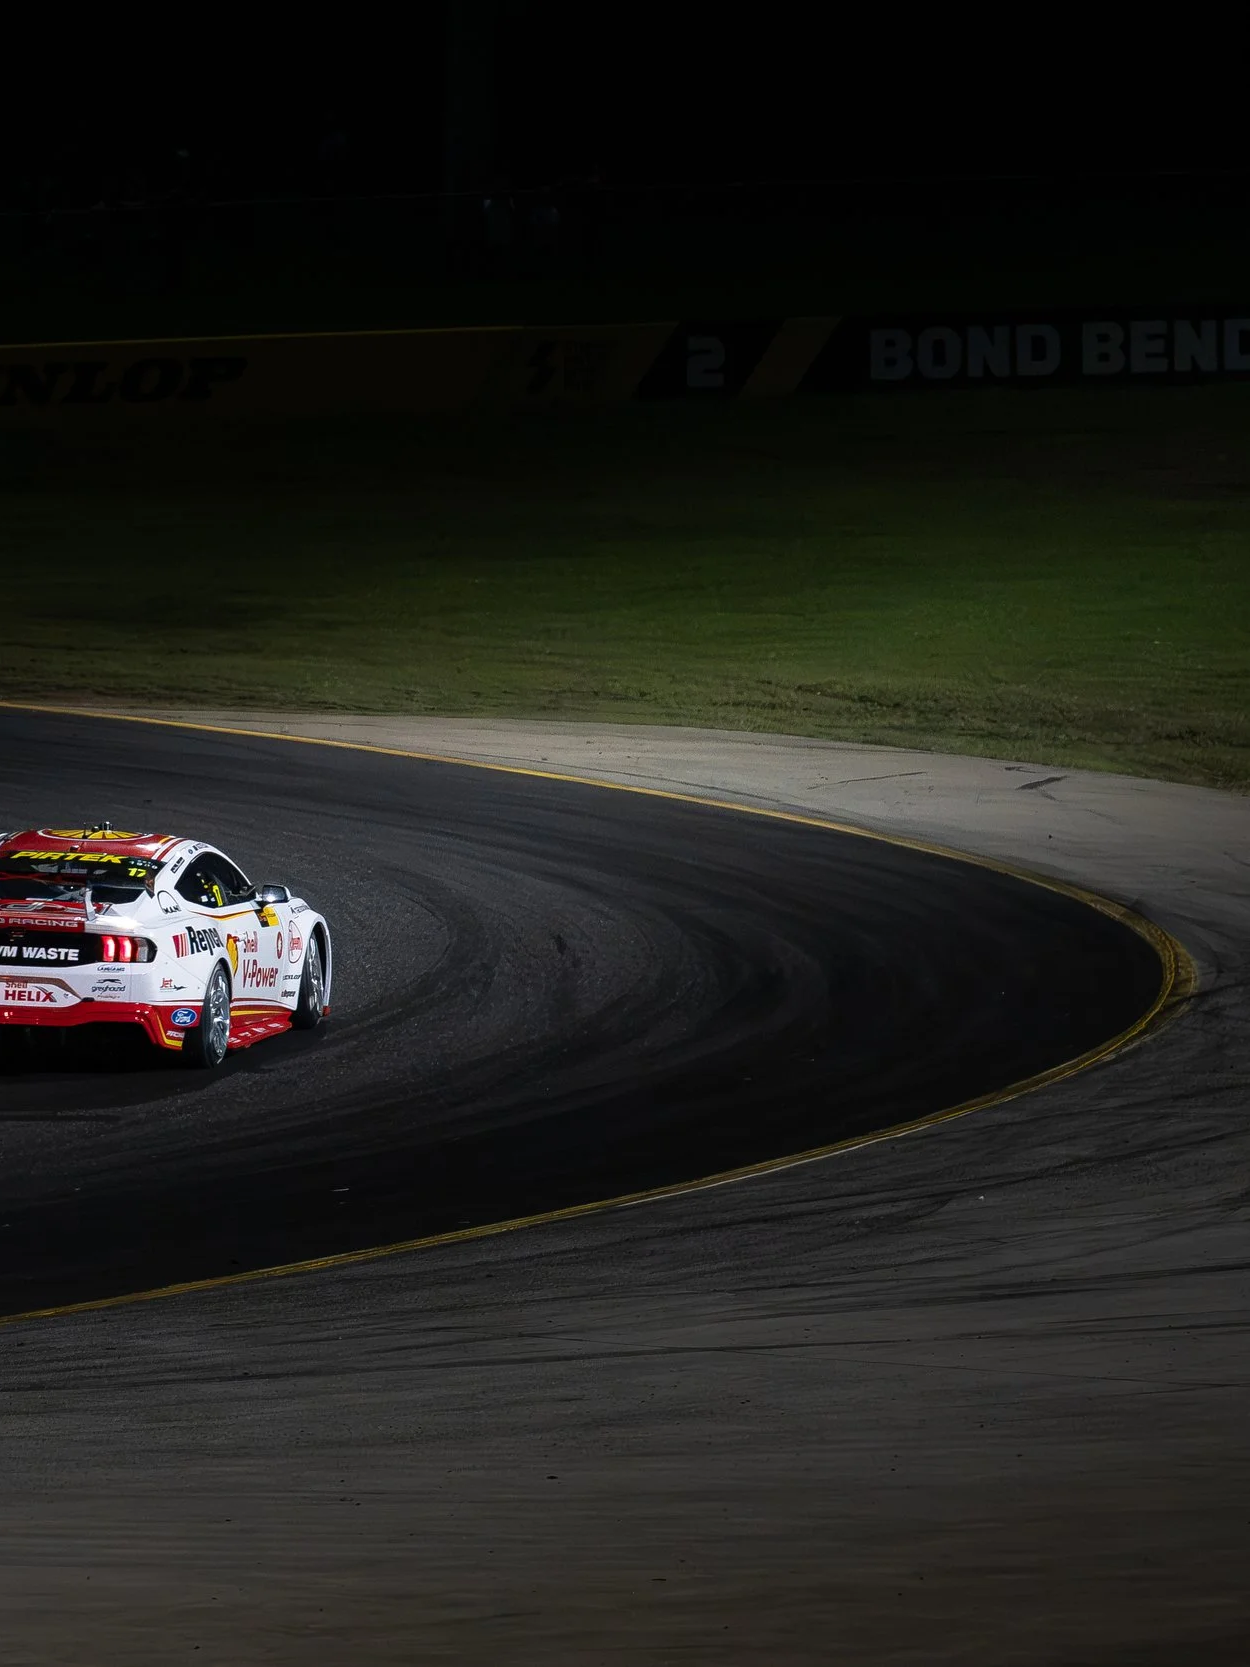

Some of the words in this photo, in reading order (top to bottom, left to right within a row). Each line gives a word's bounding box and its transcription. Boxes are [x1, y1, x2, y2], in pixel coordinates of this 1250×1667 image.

[869, 323, 1062, 381] BOND
[1082, 317, 1250, 377] BEND
[686, 336, 726, 388] 2
[11, 851, 129, 865] PIRTEK
[128, 868, 148, 878] 17
[9, 918, 80, 928] RACING
[22, 947, 80, 961] WASTE
[243, 959, 279, 988] V-Power
[4, 989, 54, 1003] HELIX
